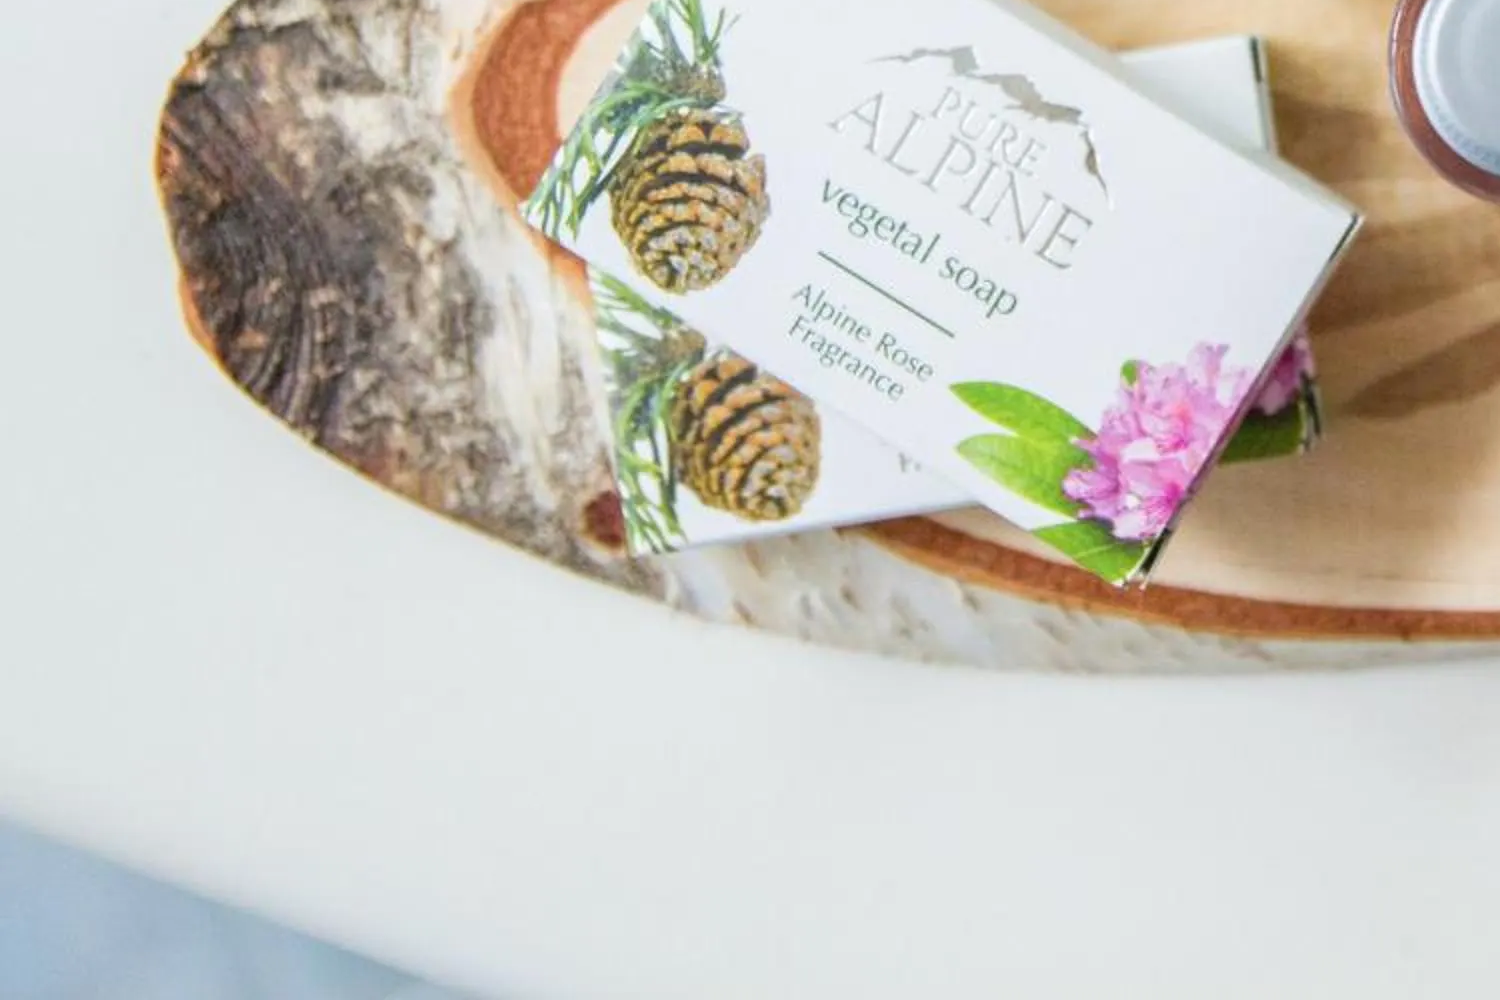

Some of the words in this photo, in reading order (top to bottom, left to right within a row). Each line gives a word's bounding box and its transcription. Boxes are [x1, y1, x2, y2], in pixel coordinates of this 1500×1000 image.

[930, 85, 1047, 177] PURE
[826, 91, 1094, 270] ALPINE
[819, 178, 941, 264] vegetal
[938, 256, 1018, 318] soap
[788, 315, 905, 401] Fragrance
[791, 284, 872, 342] Alpine
[875, 332, 934, 382] Rose
